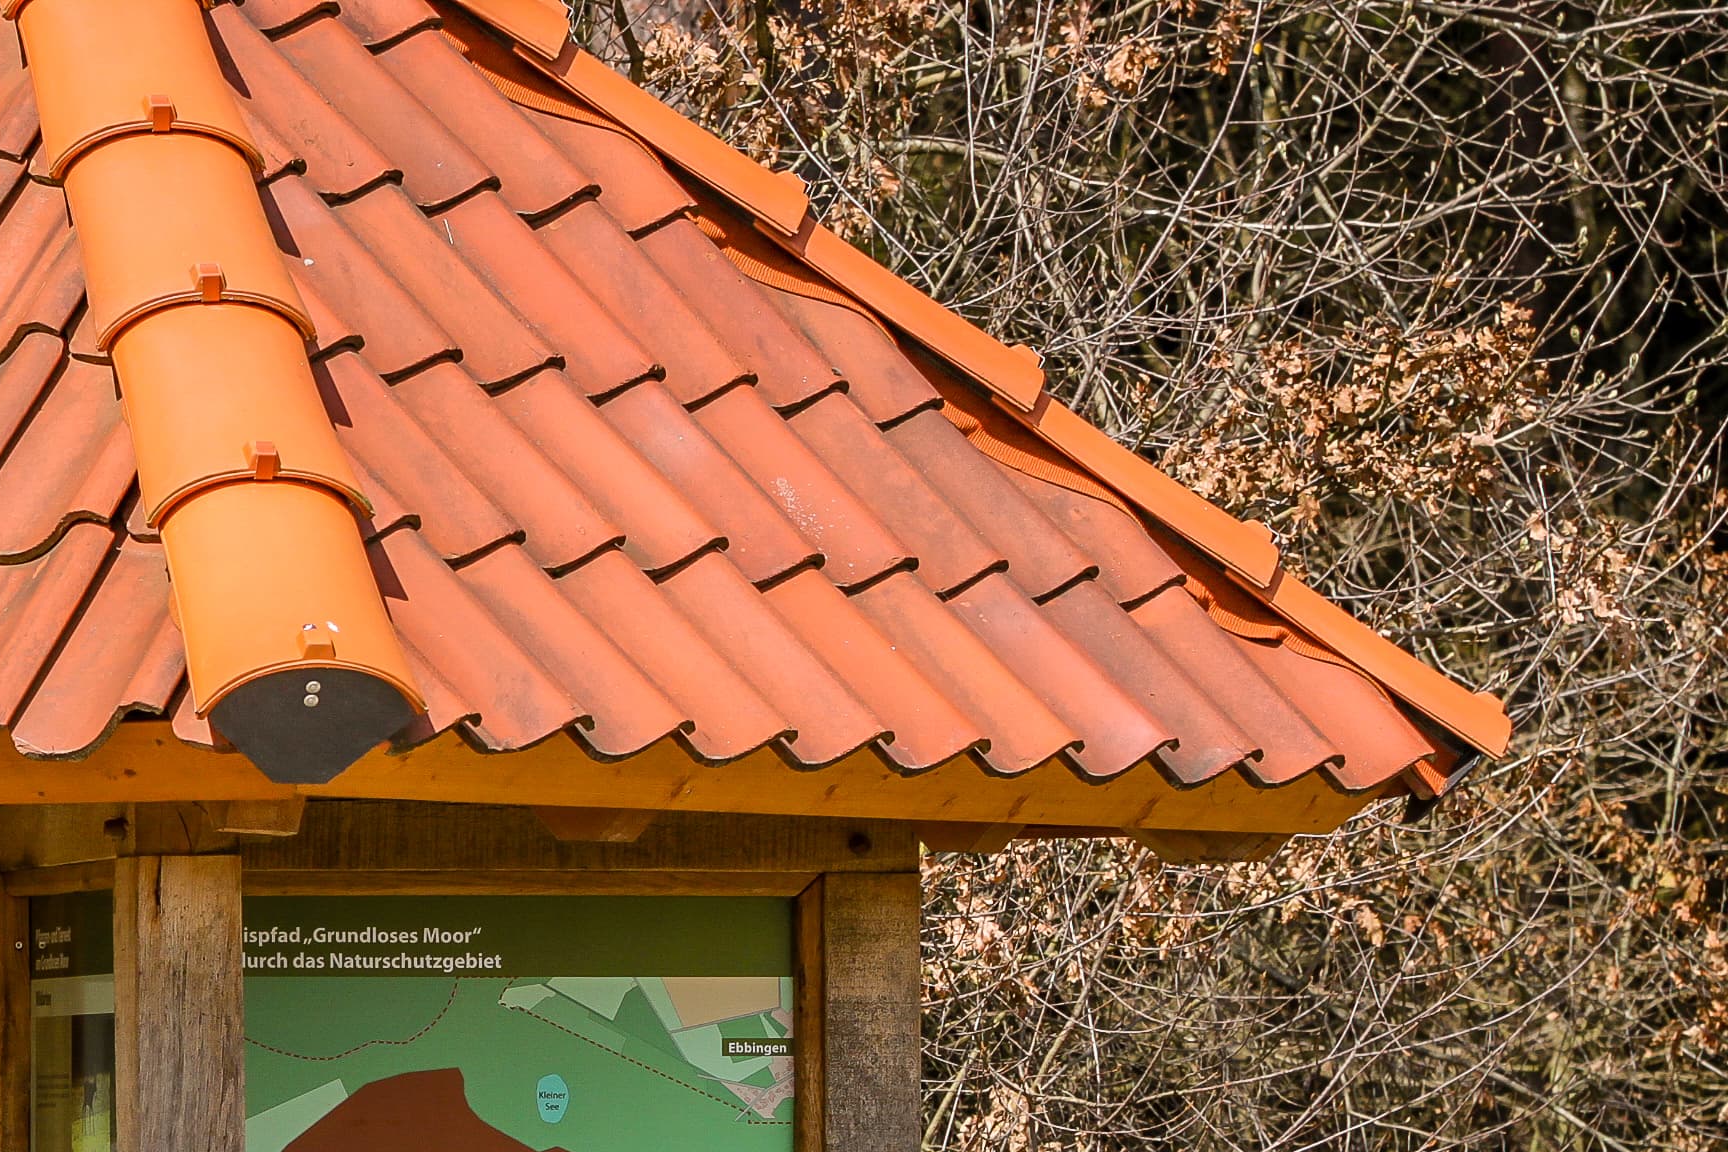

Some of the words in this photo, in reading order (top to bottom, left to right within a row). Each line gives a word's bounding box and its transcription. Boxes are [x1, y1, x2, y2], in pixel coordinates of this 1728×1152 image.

[303, 927, 418, 947] „Grundloses
[423, 927, 482, 943] Moor“
[292, 952, 324, 969] das
[329, 952, 502, 973] Naturschutzgebiet
[728, 1042, 787, 1056] Ebbingen
[538, 1091, 566, 1100] Kleiner
[545, 1103, 559, 1111] See
